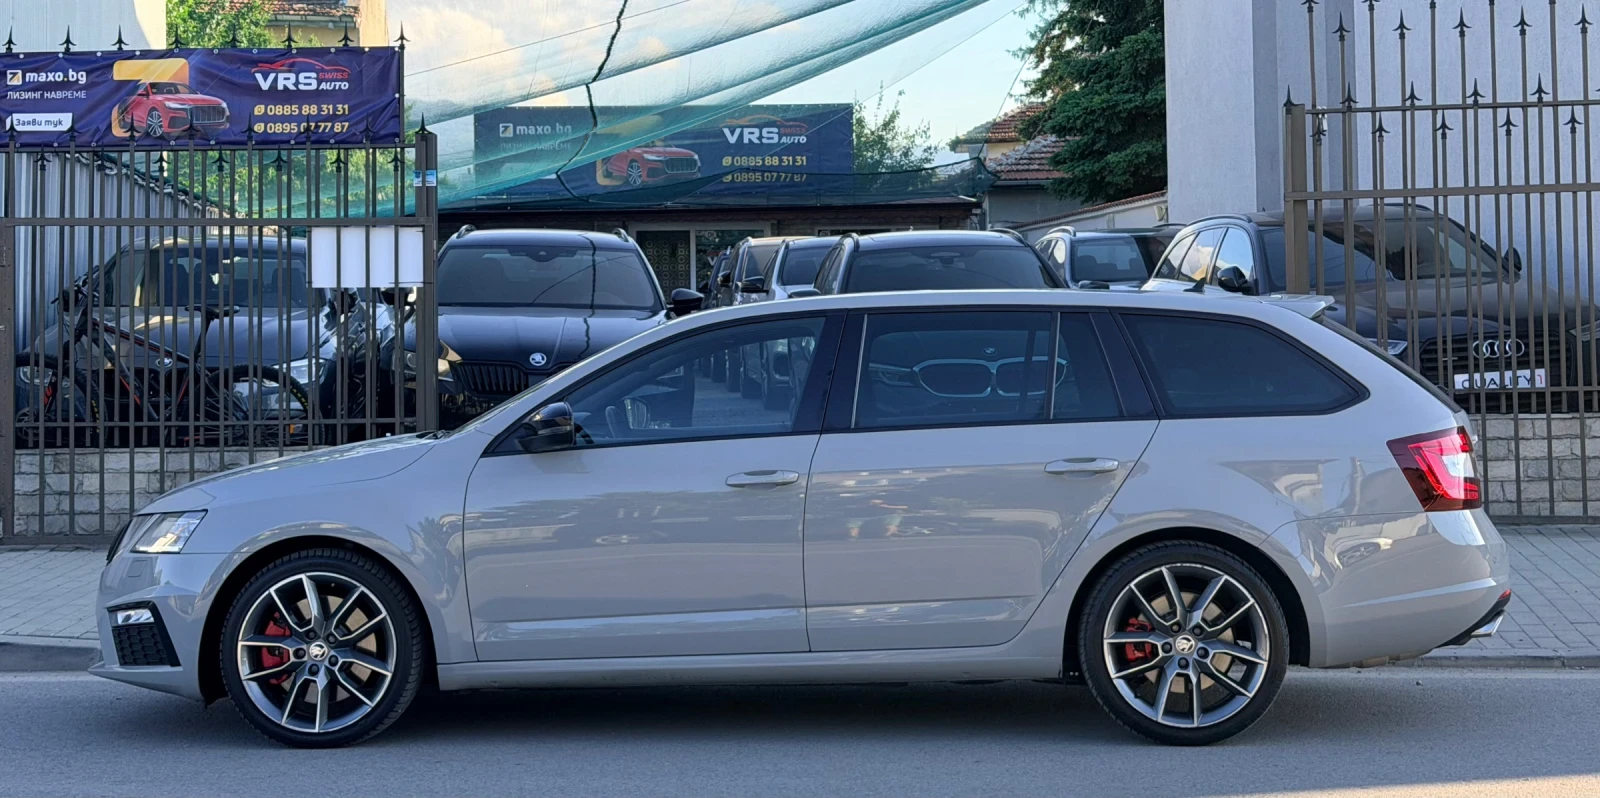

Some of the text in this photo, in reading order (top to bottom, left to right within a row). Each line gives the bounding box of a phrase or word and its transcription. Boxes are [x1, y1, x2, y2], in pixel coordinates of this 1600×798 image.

[26, 69, 87, 84] maxo.bg
[254, 72, 318, 90] VRS
[318, 82, 349, 90] AUTO
[7, 91, 87, 99] ЛИЗИНГ НАВРЕМЕ
[267, 104, 349, 115] 0885 88 31 31
[15, 118, 42, 126] Заяви
[266, 123, 298, 133] 0895
[317, 122, 332, 133] 77
[333, 122, 349, 133] 87
[722, 127, 779, 144] VRS
[780, 136, 807, 144] AUTO
[733, 156, 807, 166] 0885 88 31 31
[733, 172, 762, 182] 0895
[764, 172, 777, 182] 07
